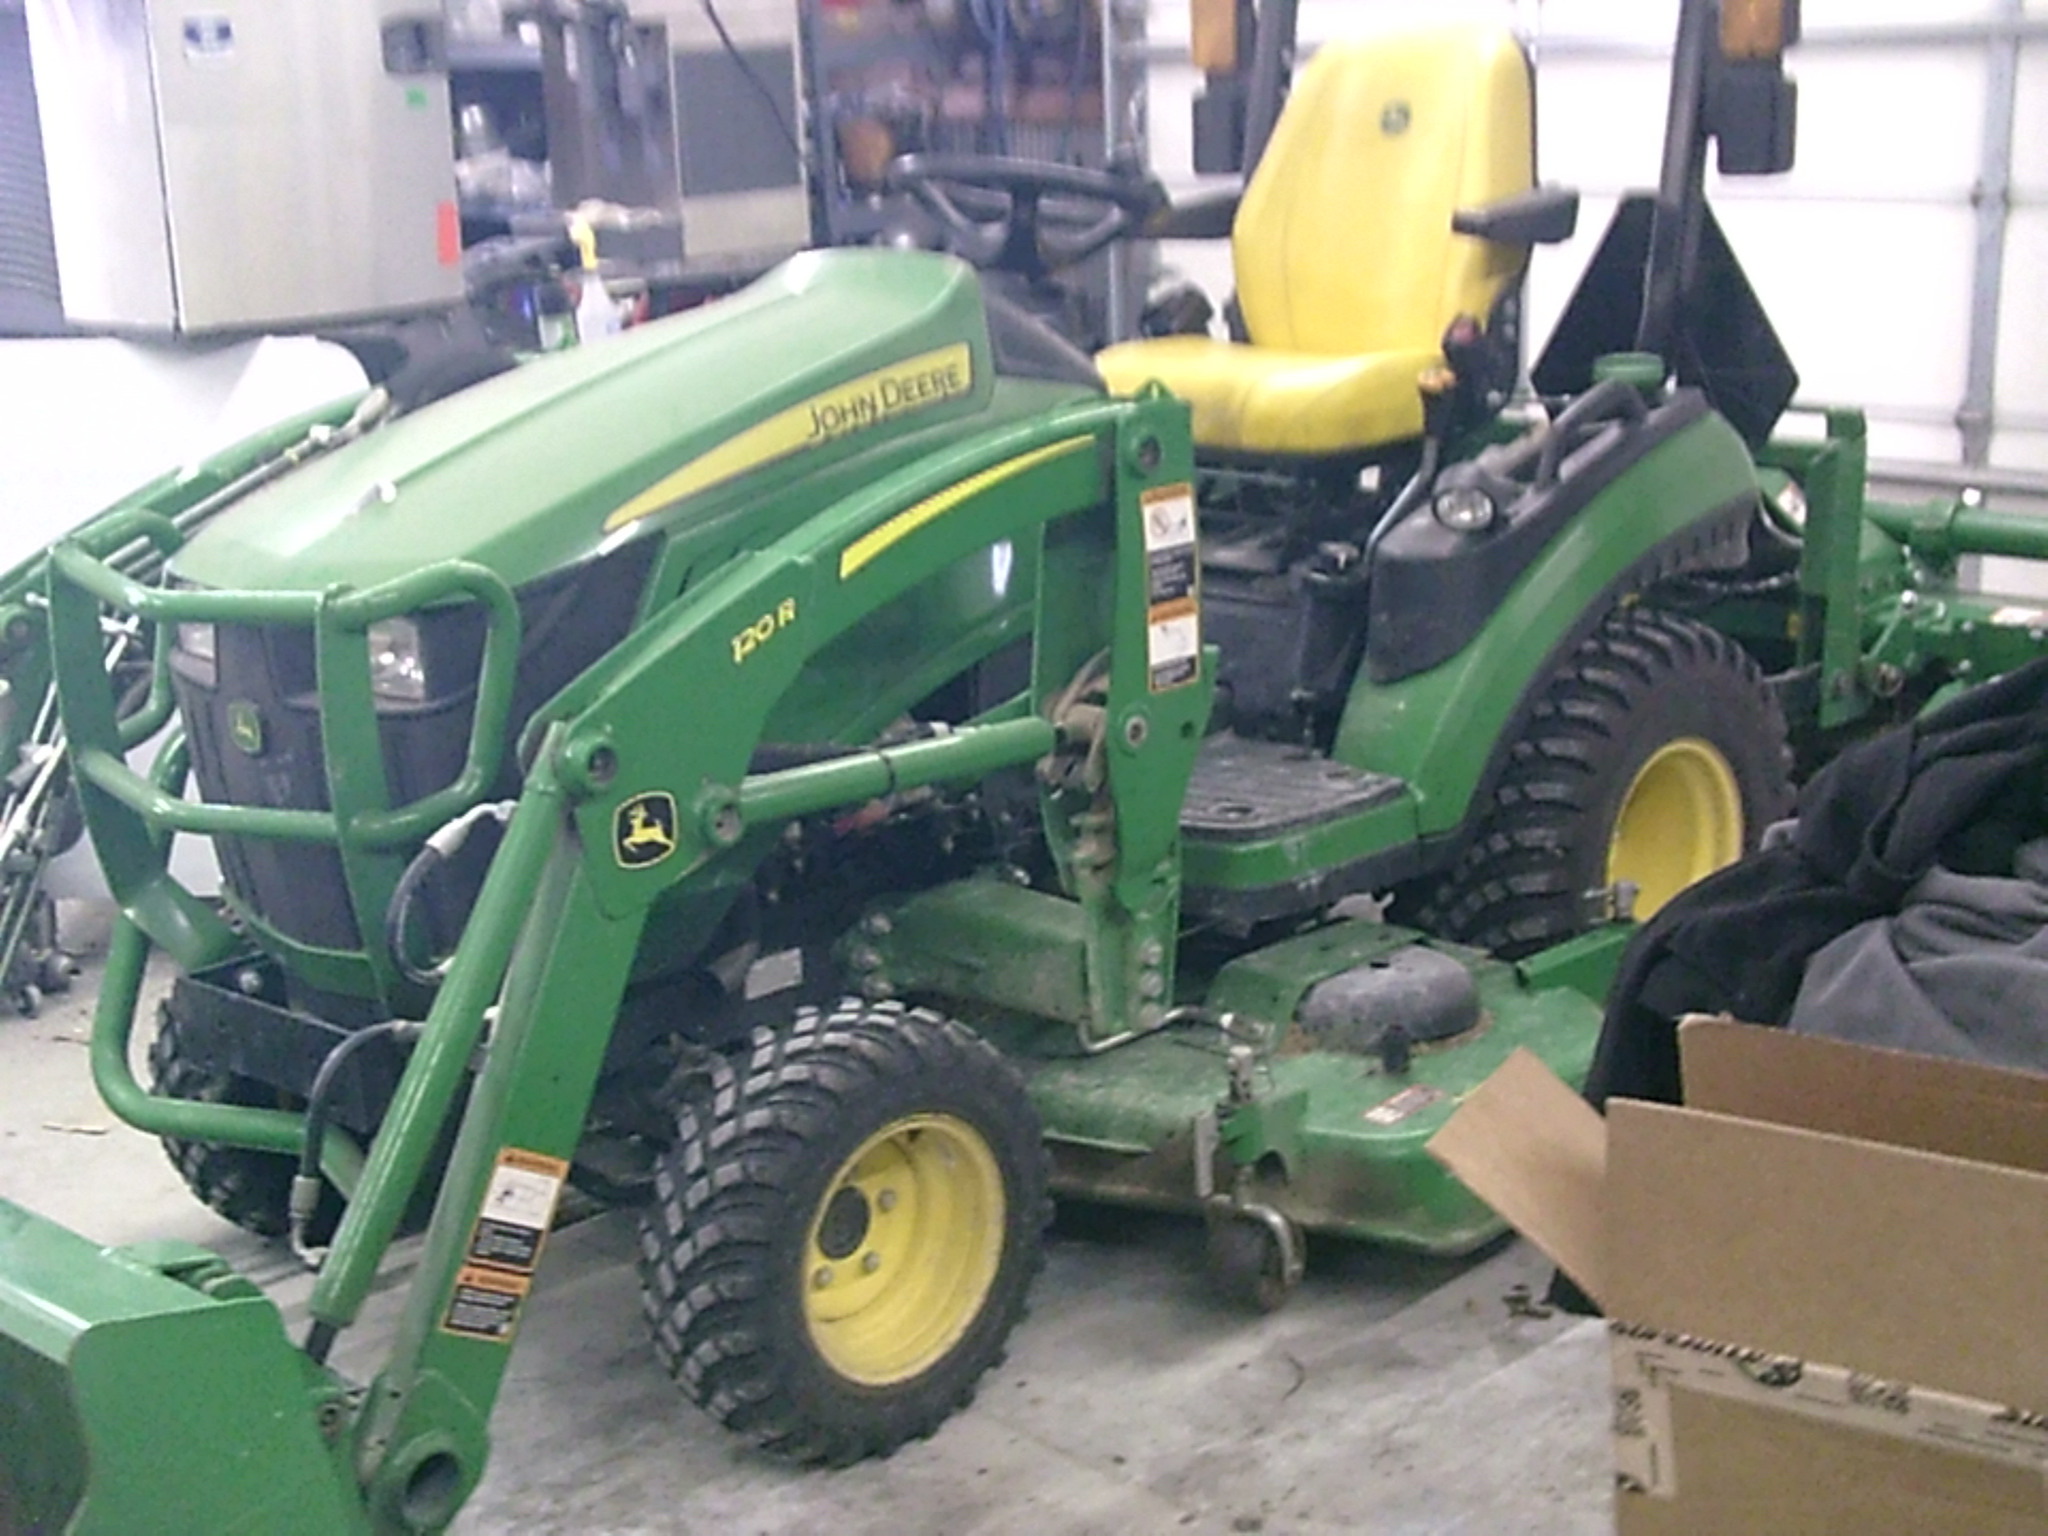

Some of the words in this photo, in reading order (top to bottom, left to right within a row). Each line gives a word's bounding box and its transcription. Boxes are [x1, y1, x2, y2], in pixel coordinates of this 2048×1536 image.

[808, 391, 877, 439] JOHN
[879, 364, 962, 409] DEERE
[731, 613, 775, 664] 120
